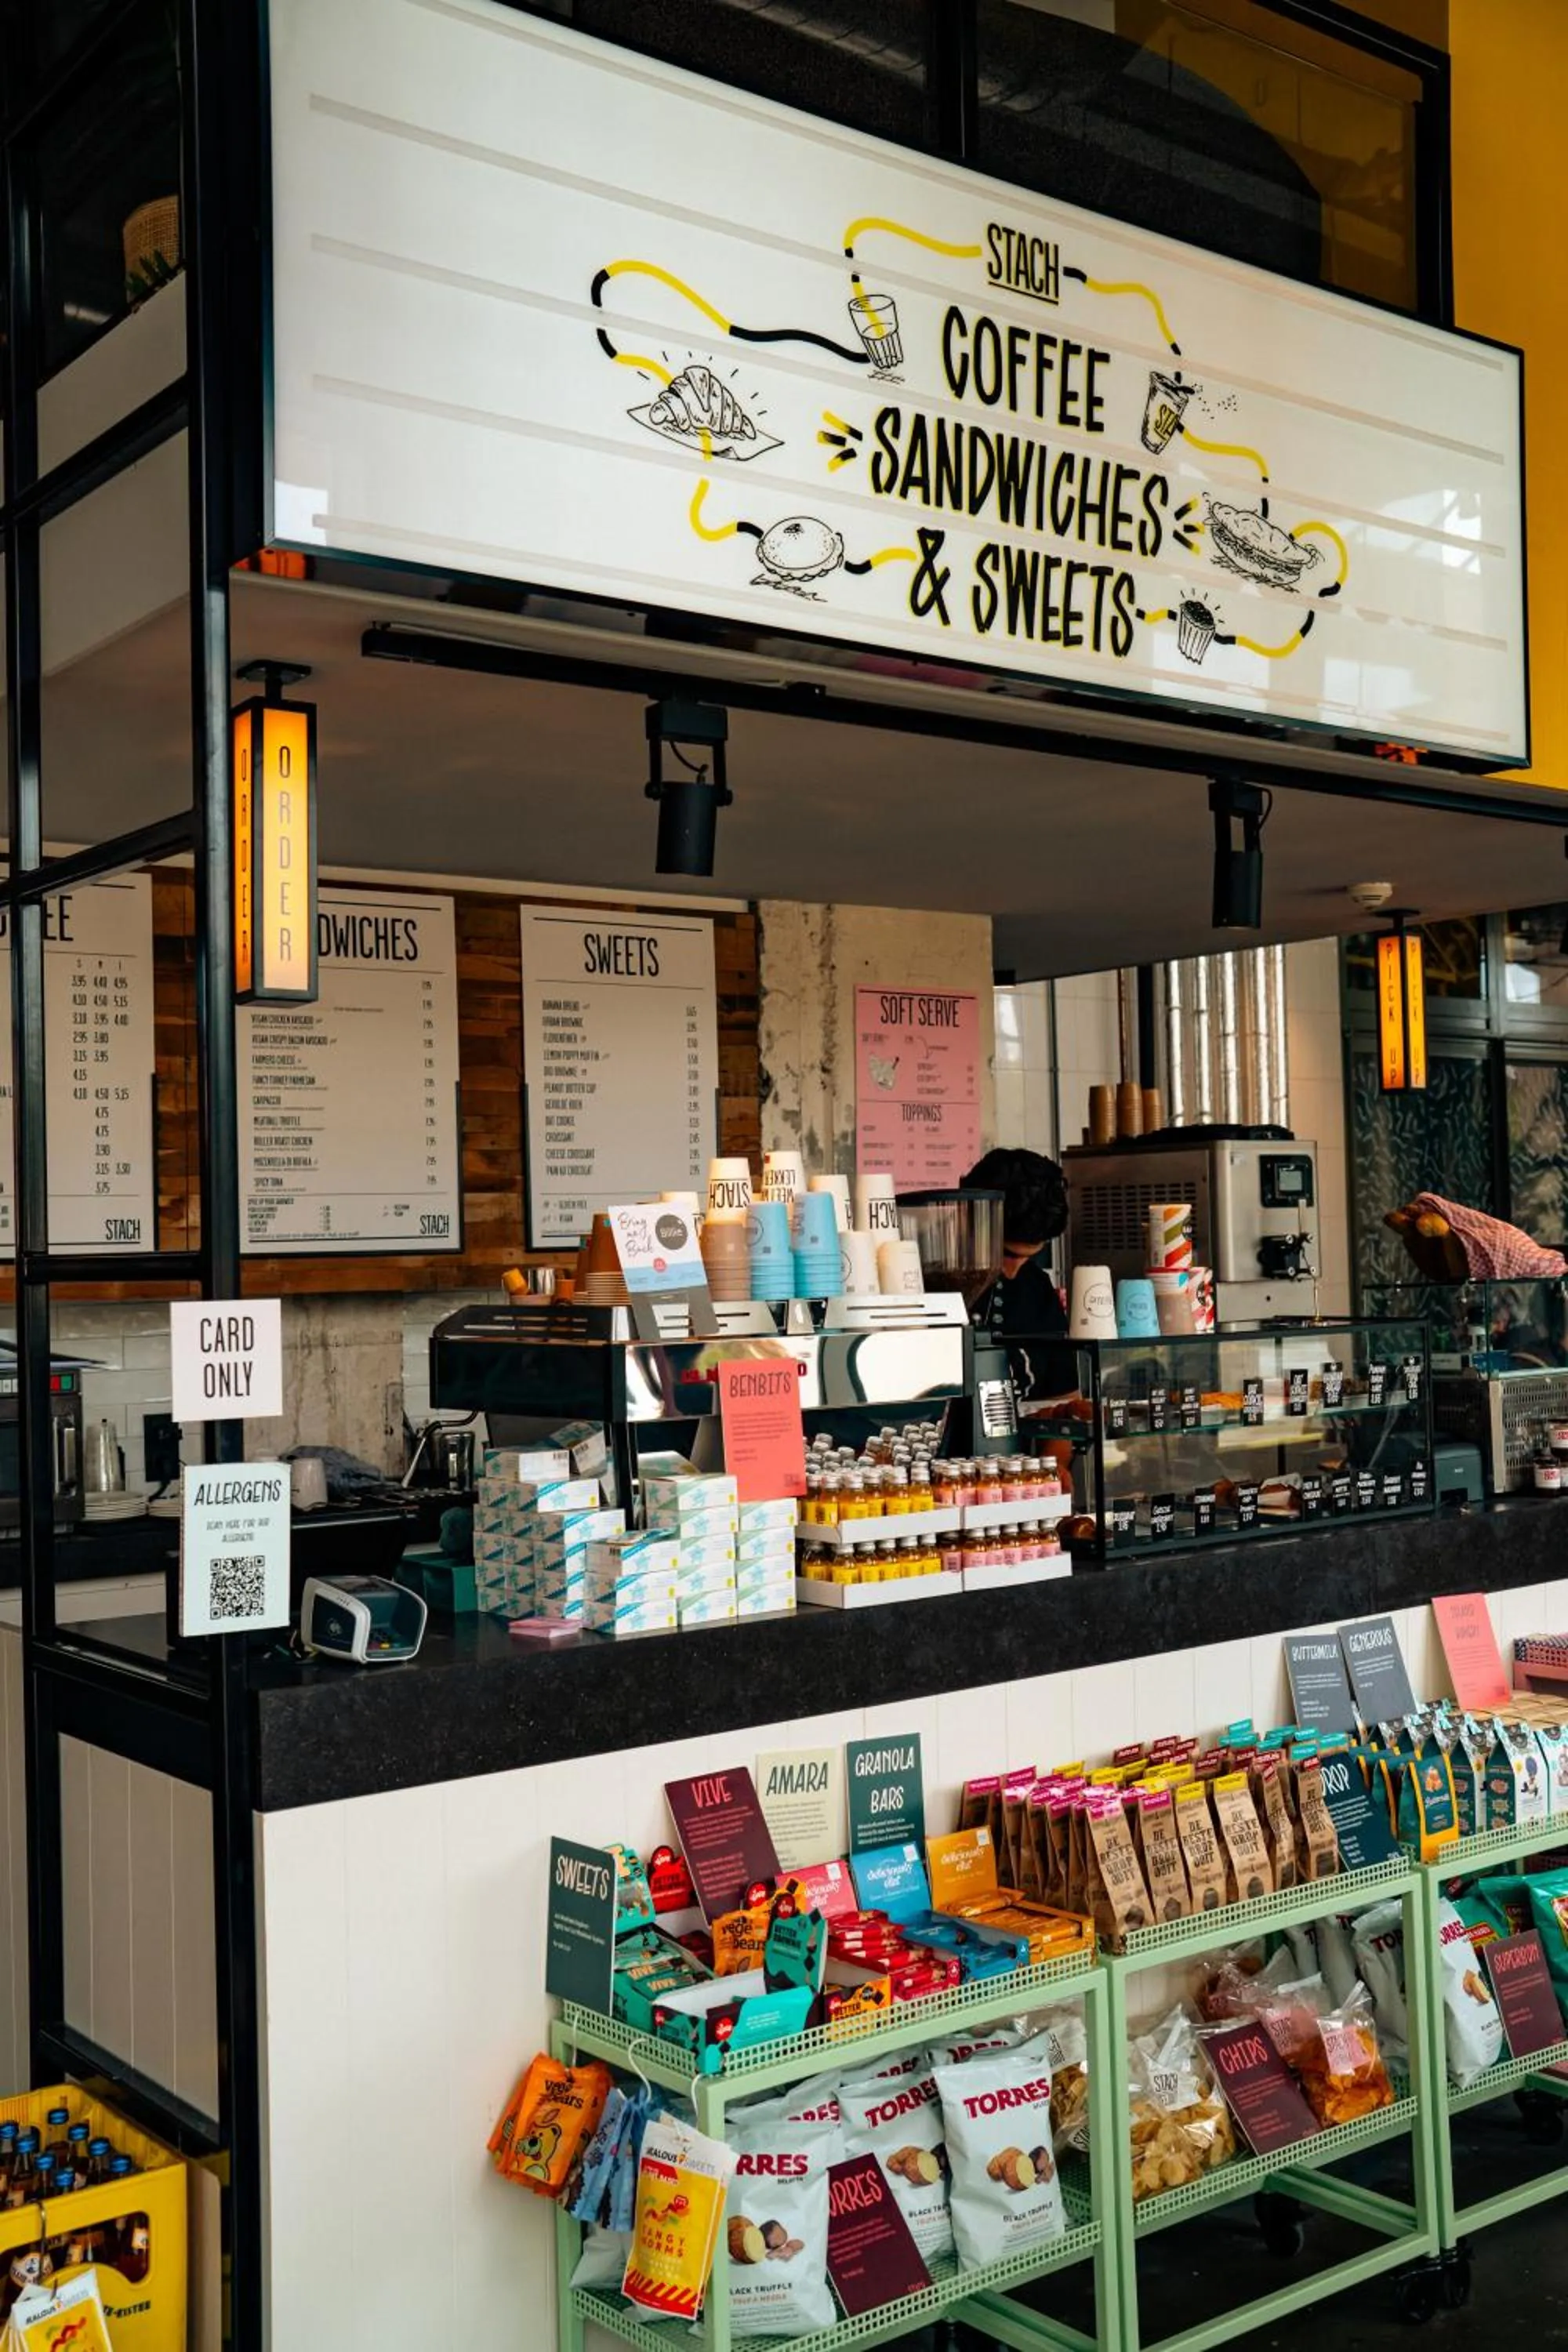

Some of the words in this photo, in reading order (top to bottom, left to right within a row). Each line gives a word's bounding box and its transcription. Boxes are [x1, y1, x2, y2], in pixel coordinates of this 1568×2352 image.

[985, 223, 1059, 301] STACH
[940, 306, 1110, 433] COFFEE
[871, 407, 1169, 557] SANDWICHES
[909, 527, 951, 626] &
[973, 543, 1137, 659] SWEETS
[278, 745, 292, 963] ORDER
[318, 913, 419, 961] DWICHES
[583, 933, 659, 977] SWEETS
[880, 995, 914, 1025] SOFT
[918, 998, 960, 1028] SERVE
[902, 1102, 942, 1122] TOPPINGS
[709, 1181, 751, 1209] STACH
[105, 1219, 141, 1240] STACH
[419, 1214, 449, 1234] STACH
[200, 1316, 254, 1353] CARD
[203, 1361, 253, 1399] ONLY
[729, 1371, 792, 1398] BENBITS
[194, 1479, 281, 1507] ALLERGENS
[1348, 1627, 1393, 1653] GENEROUS
[855, 1746, 915, 1777] GRANOLA
[691, 1776, 734, 1809] VIVE
[766, 1762, 829, 1797] AMARA
[870, 1785, 905, 1813] BARS
[555, 1854, 610, 1901] SWEETS
[1218, 2035, 1269, 2074] CHIPS
[544, 2079, 573, 2094] vege
[963, 2077, 1051, 2119] TORRES
[735, 2154, 808, 2176] RRES
[729, 2286, 752, 2296] LACK
[755, 2282, 793, 2292] TRUFFLE
